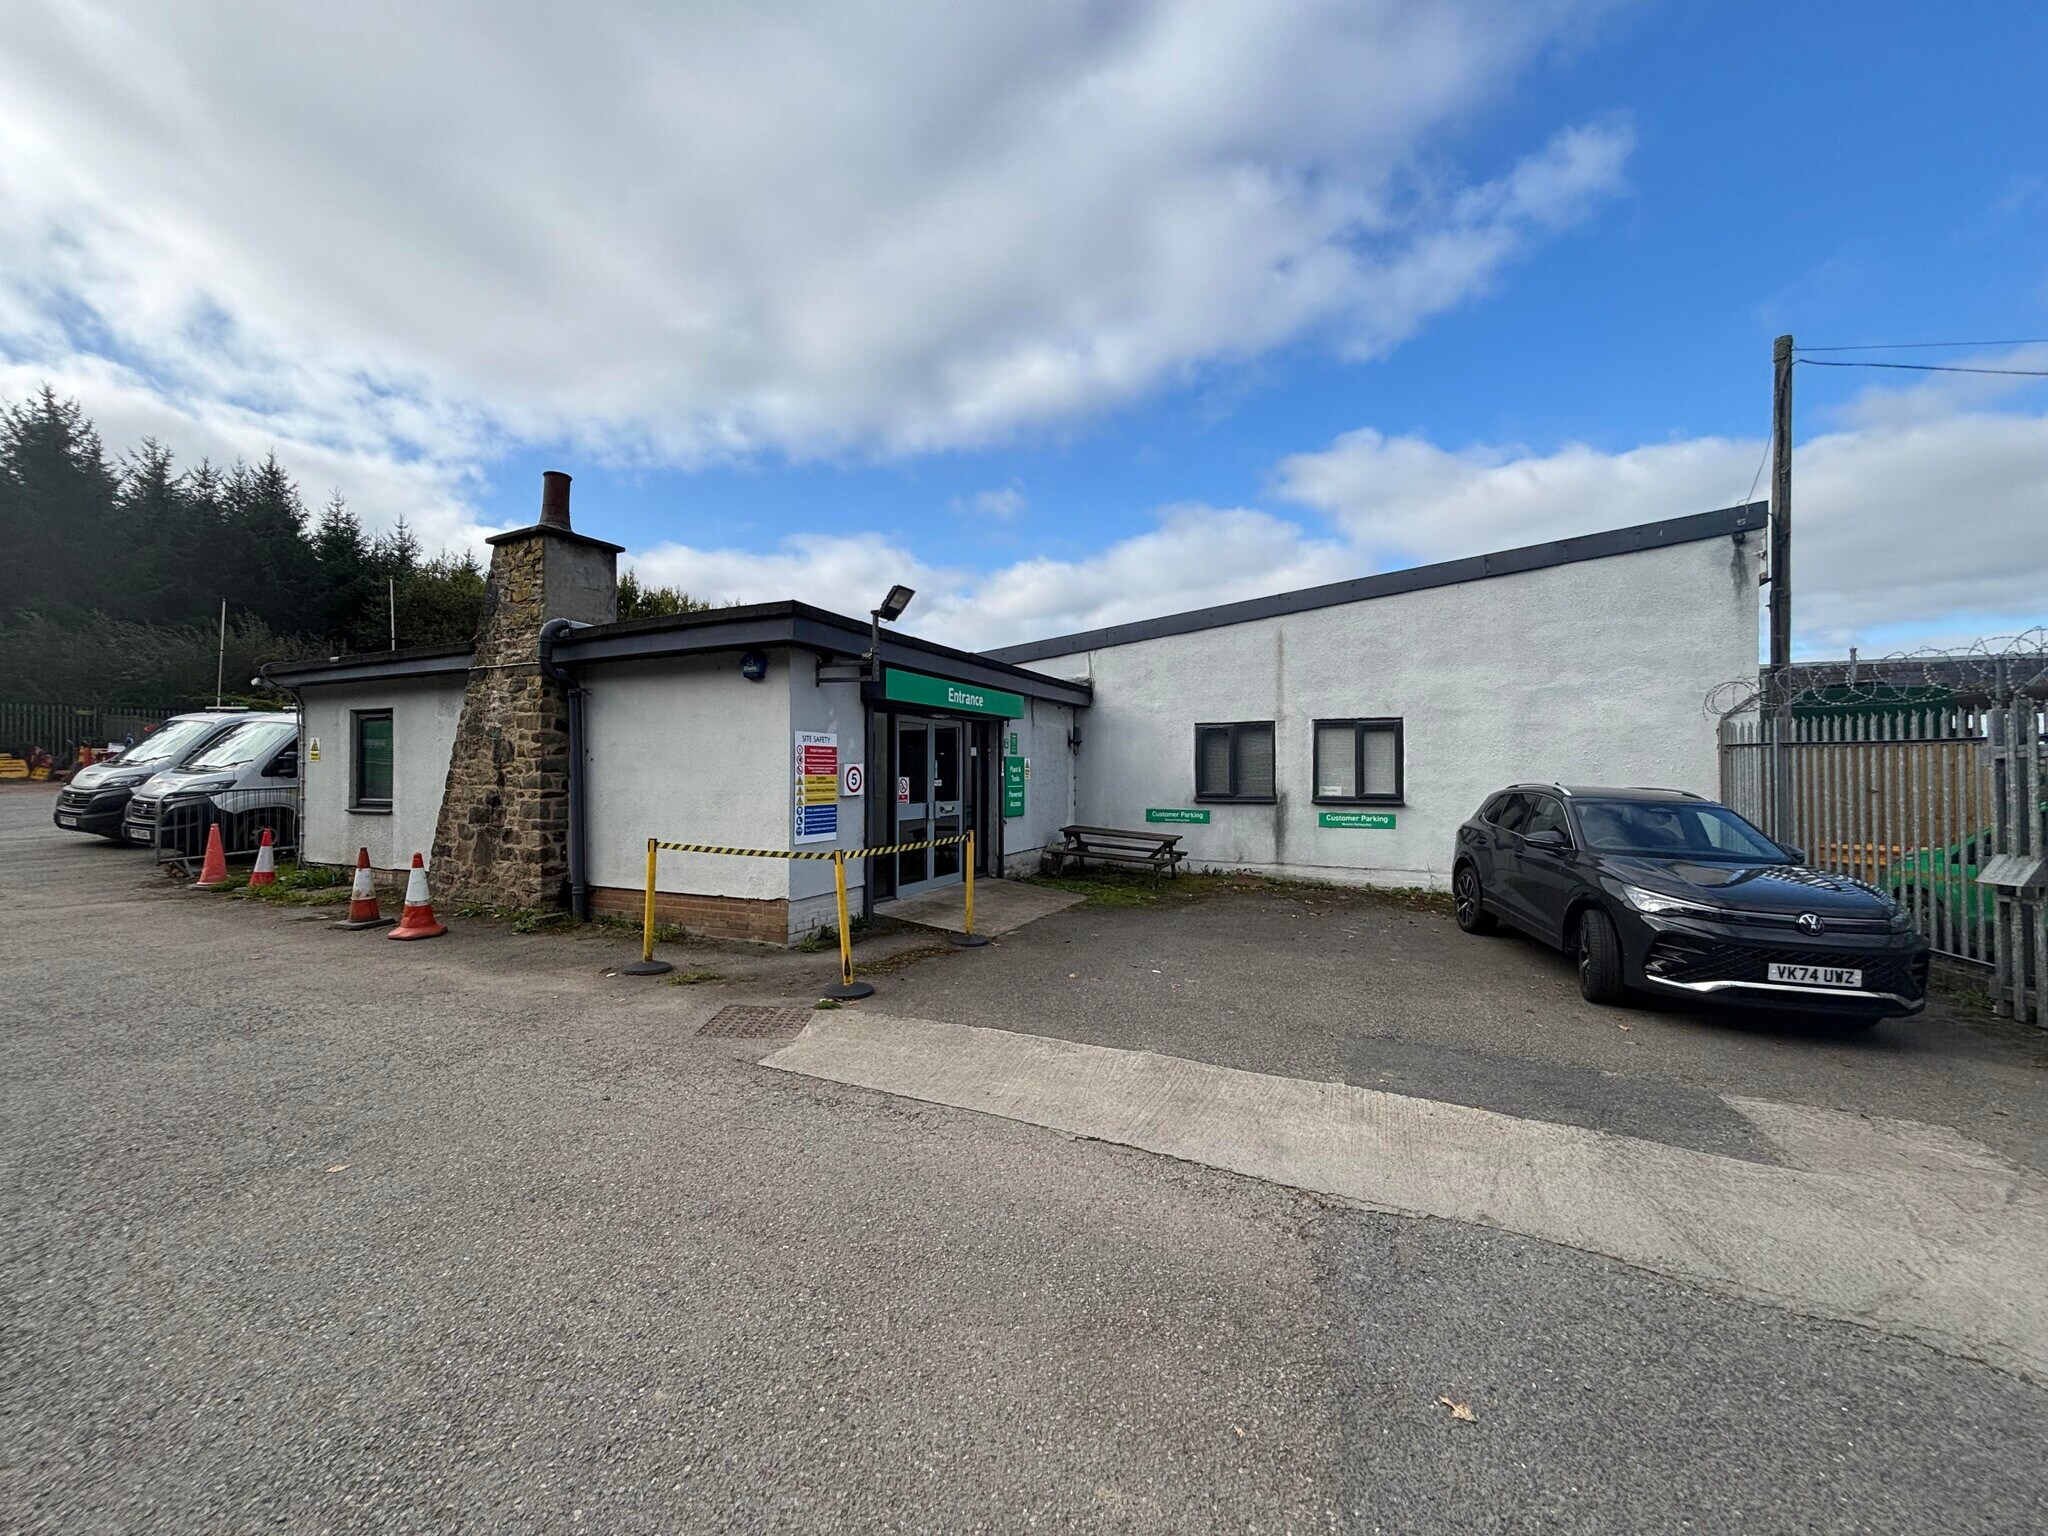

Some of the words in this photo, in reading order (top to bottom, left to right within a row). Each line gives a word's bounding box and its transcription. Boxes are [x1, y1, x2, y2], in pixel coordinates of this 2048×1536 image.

[948, 687, 984, 707] Entrance
[802, 735, 812, 743] SITE
[1009, 765, 1018, 773] Plant
[851, 773, 857, 786] 5
[1151, 810, 1180, 818] Customer
[1180, 811, 1204, 820] Parking
[1326, 814, 1360, 822] Customer
[1361, 815, 1389, 824] Parking
[1777, 965, 1819, 982] VK74
[1823, 969, 1854, 985] UWZ
